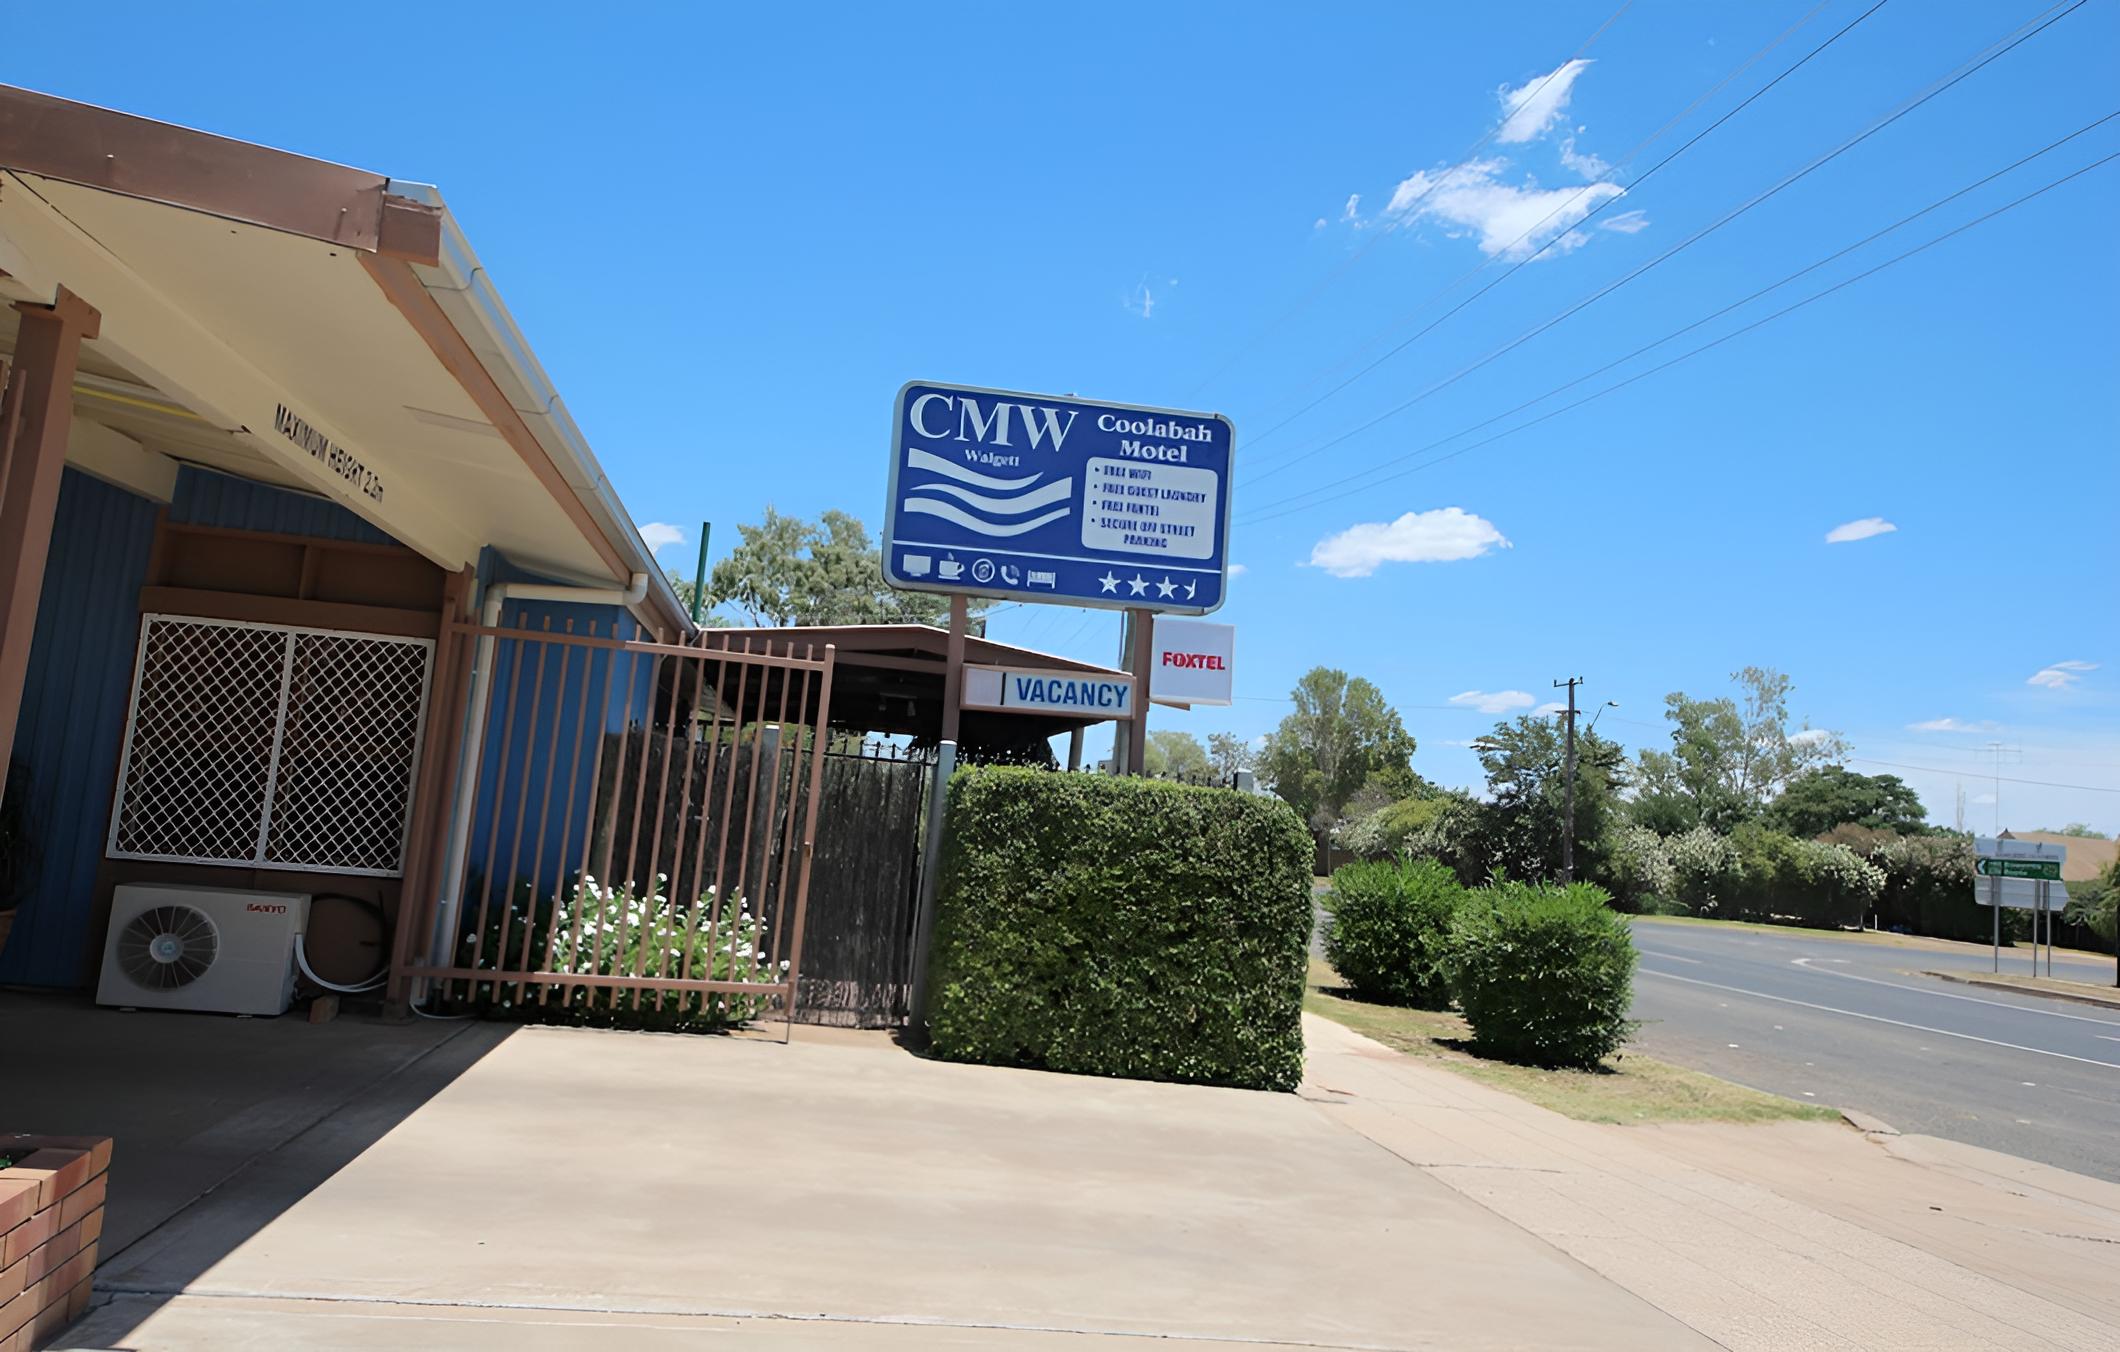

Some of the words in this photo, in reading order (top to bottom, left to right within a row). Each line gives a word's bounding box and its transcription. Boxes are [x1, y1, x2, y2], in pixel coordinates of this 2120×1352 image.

[910, 393, 1079, 452] CMW
[1097, 414, 1212, 443] Coolabah
[1120, 439, 1187, 463] Motel
[1162, 651, 1226, 671] FOXTEL
[1016, 677, 1128, 708] VACANCY
